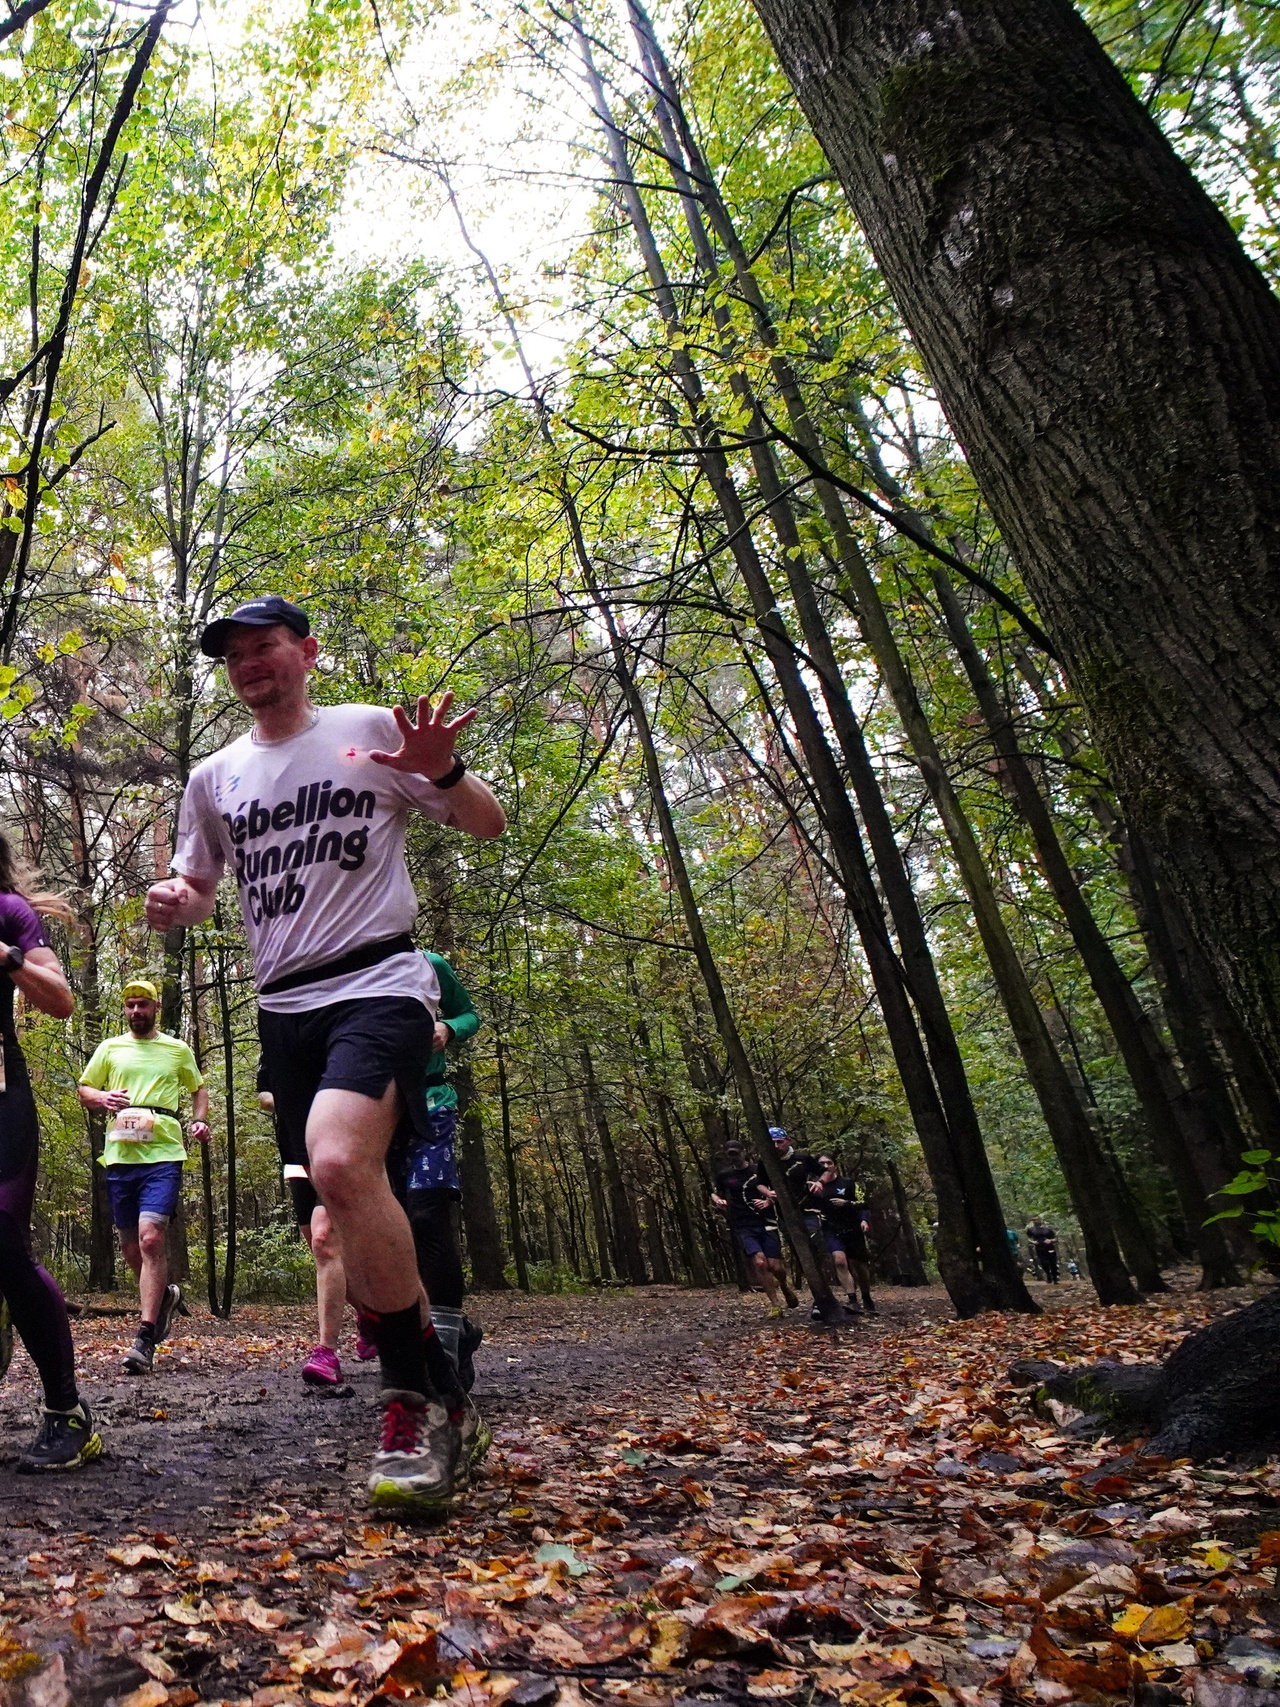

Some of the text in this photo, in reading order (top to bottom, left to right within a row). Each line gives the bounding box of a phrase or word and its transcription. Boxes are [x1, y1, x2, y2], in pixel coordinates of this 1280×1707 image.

[235, 824, 370, 889] Running
[248, 873, 306, 927] Club
[124, 1120, 136, 1129] 11
